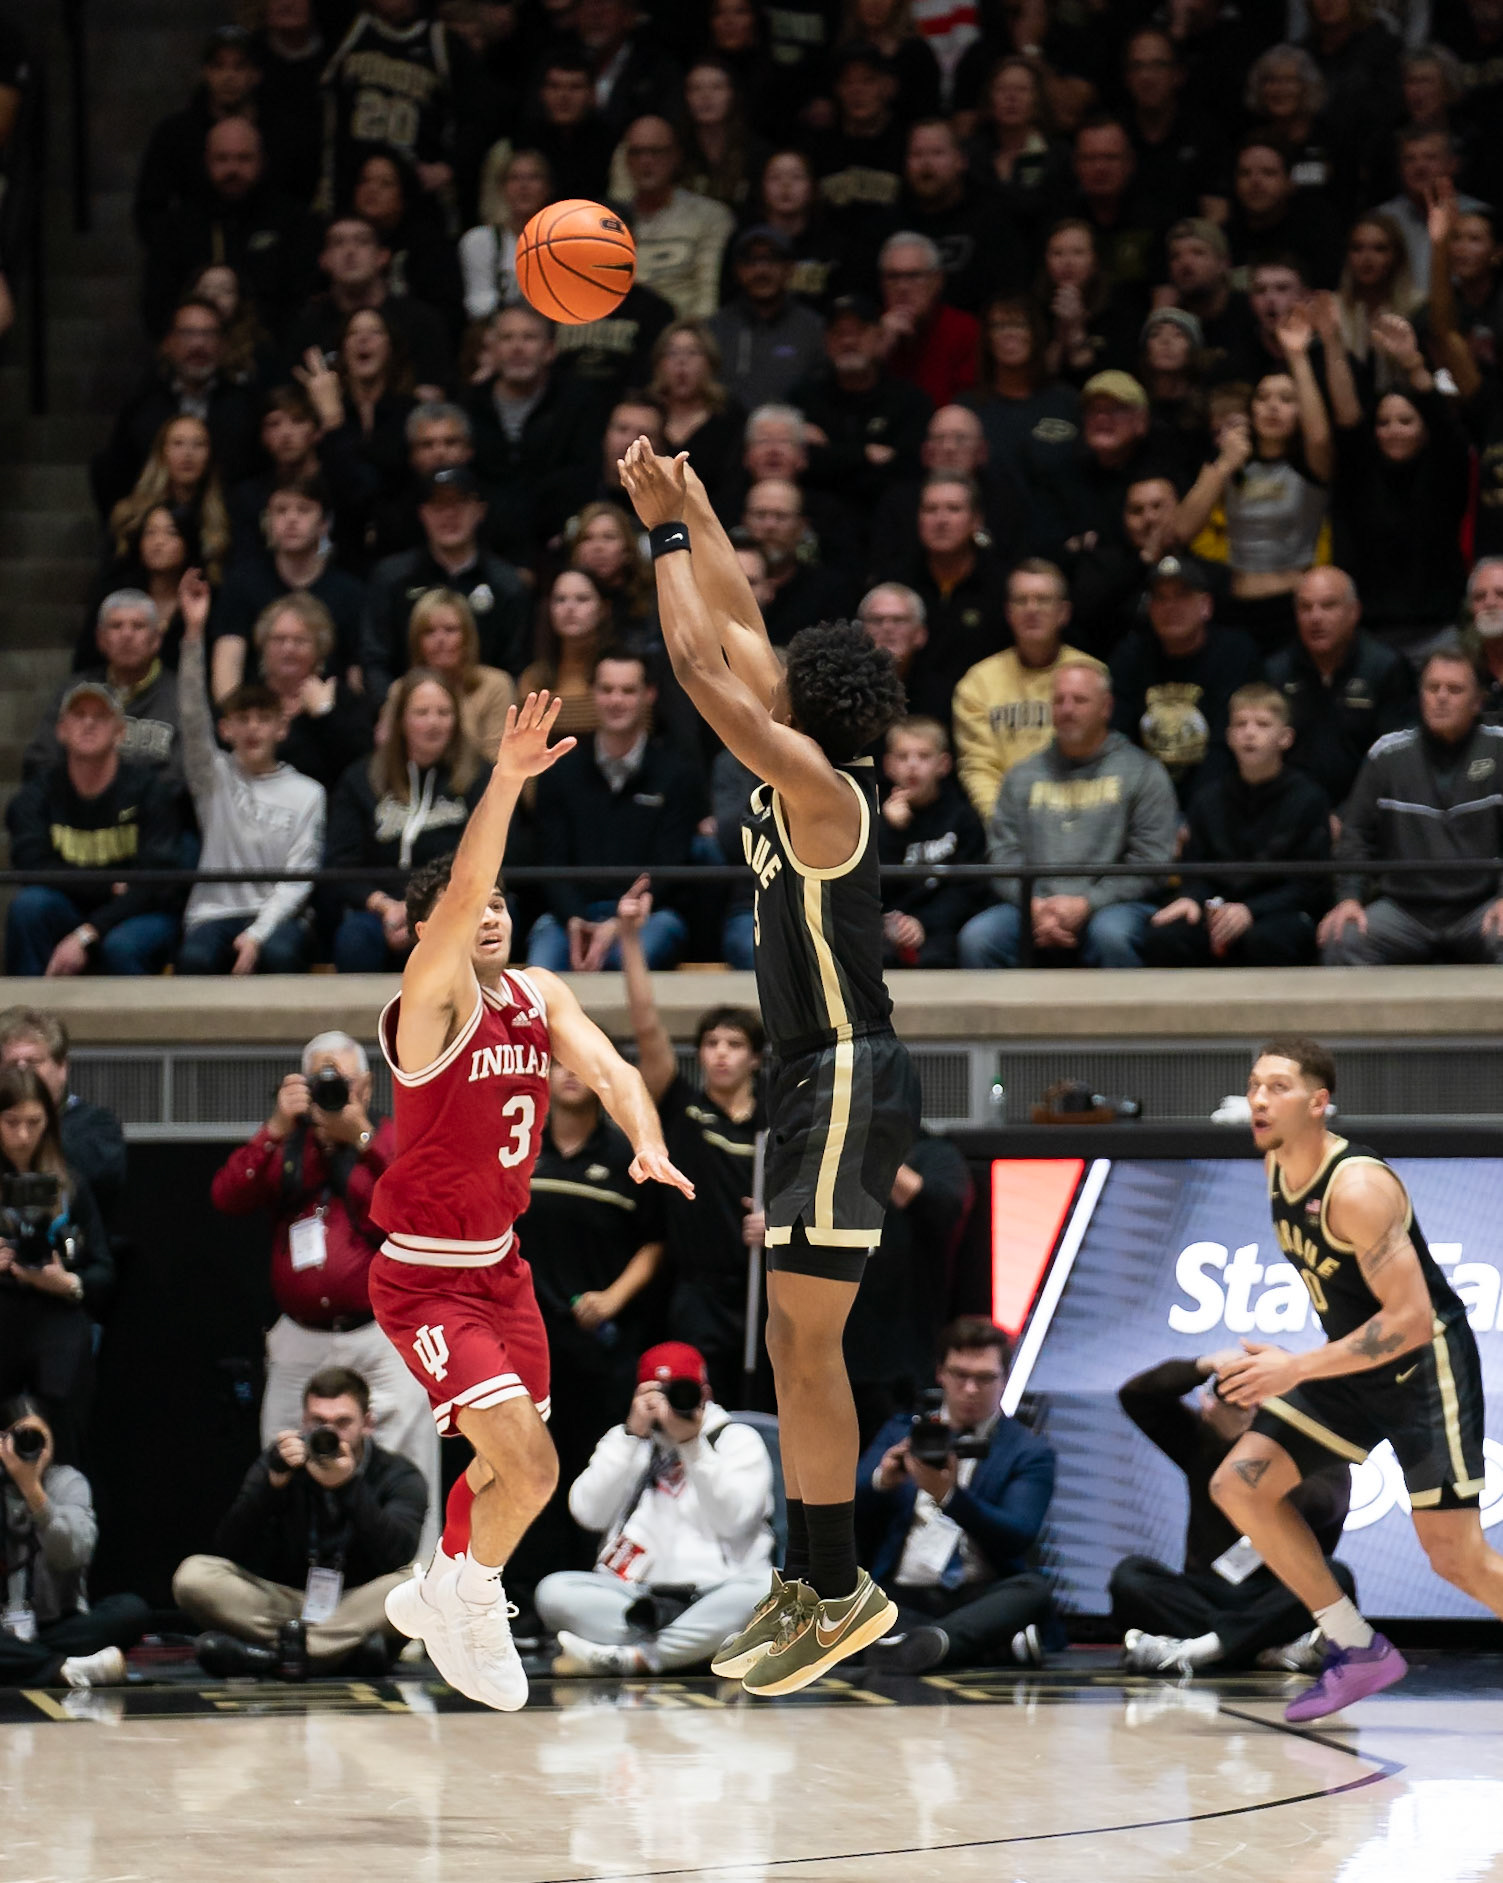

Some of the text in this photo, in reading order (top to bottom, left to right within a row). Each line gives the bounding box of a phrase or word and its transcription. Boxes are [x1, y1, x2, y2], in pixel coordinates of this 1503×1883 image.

[498, 1095, 535, 1168] 3
[1168, 1241, 1323, 1334] Sta
[1300, 1268, 1329, 1312] 0
